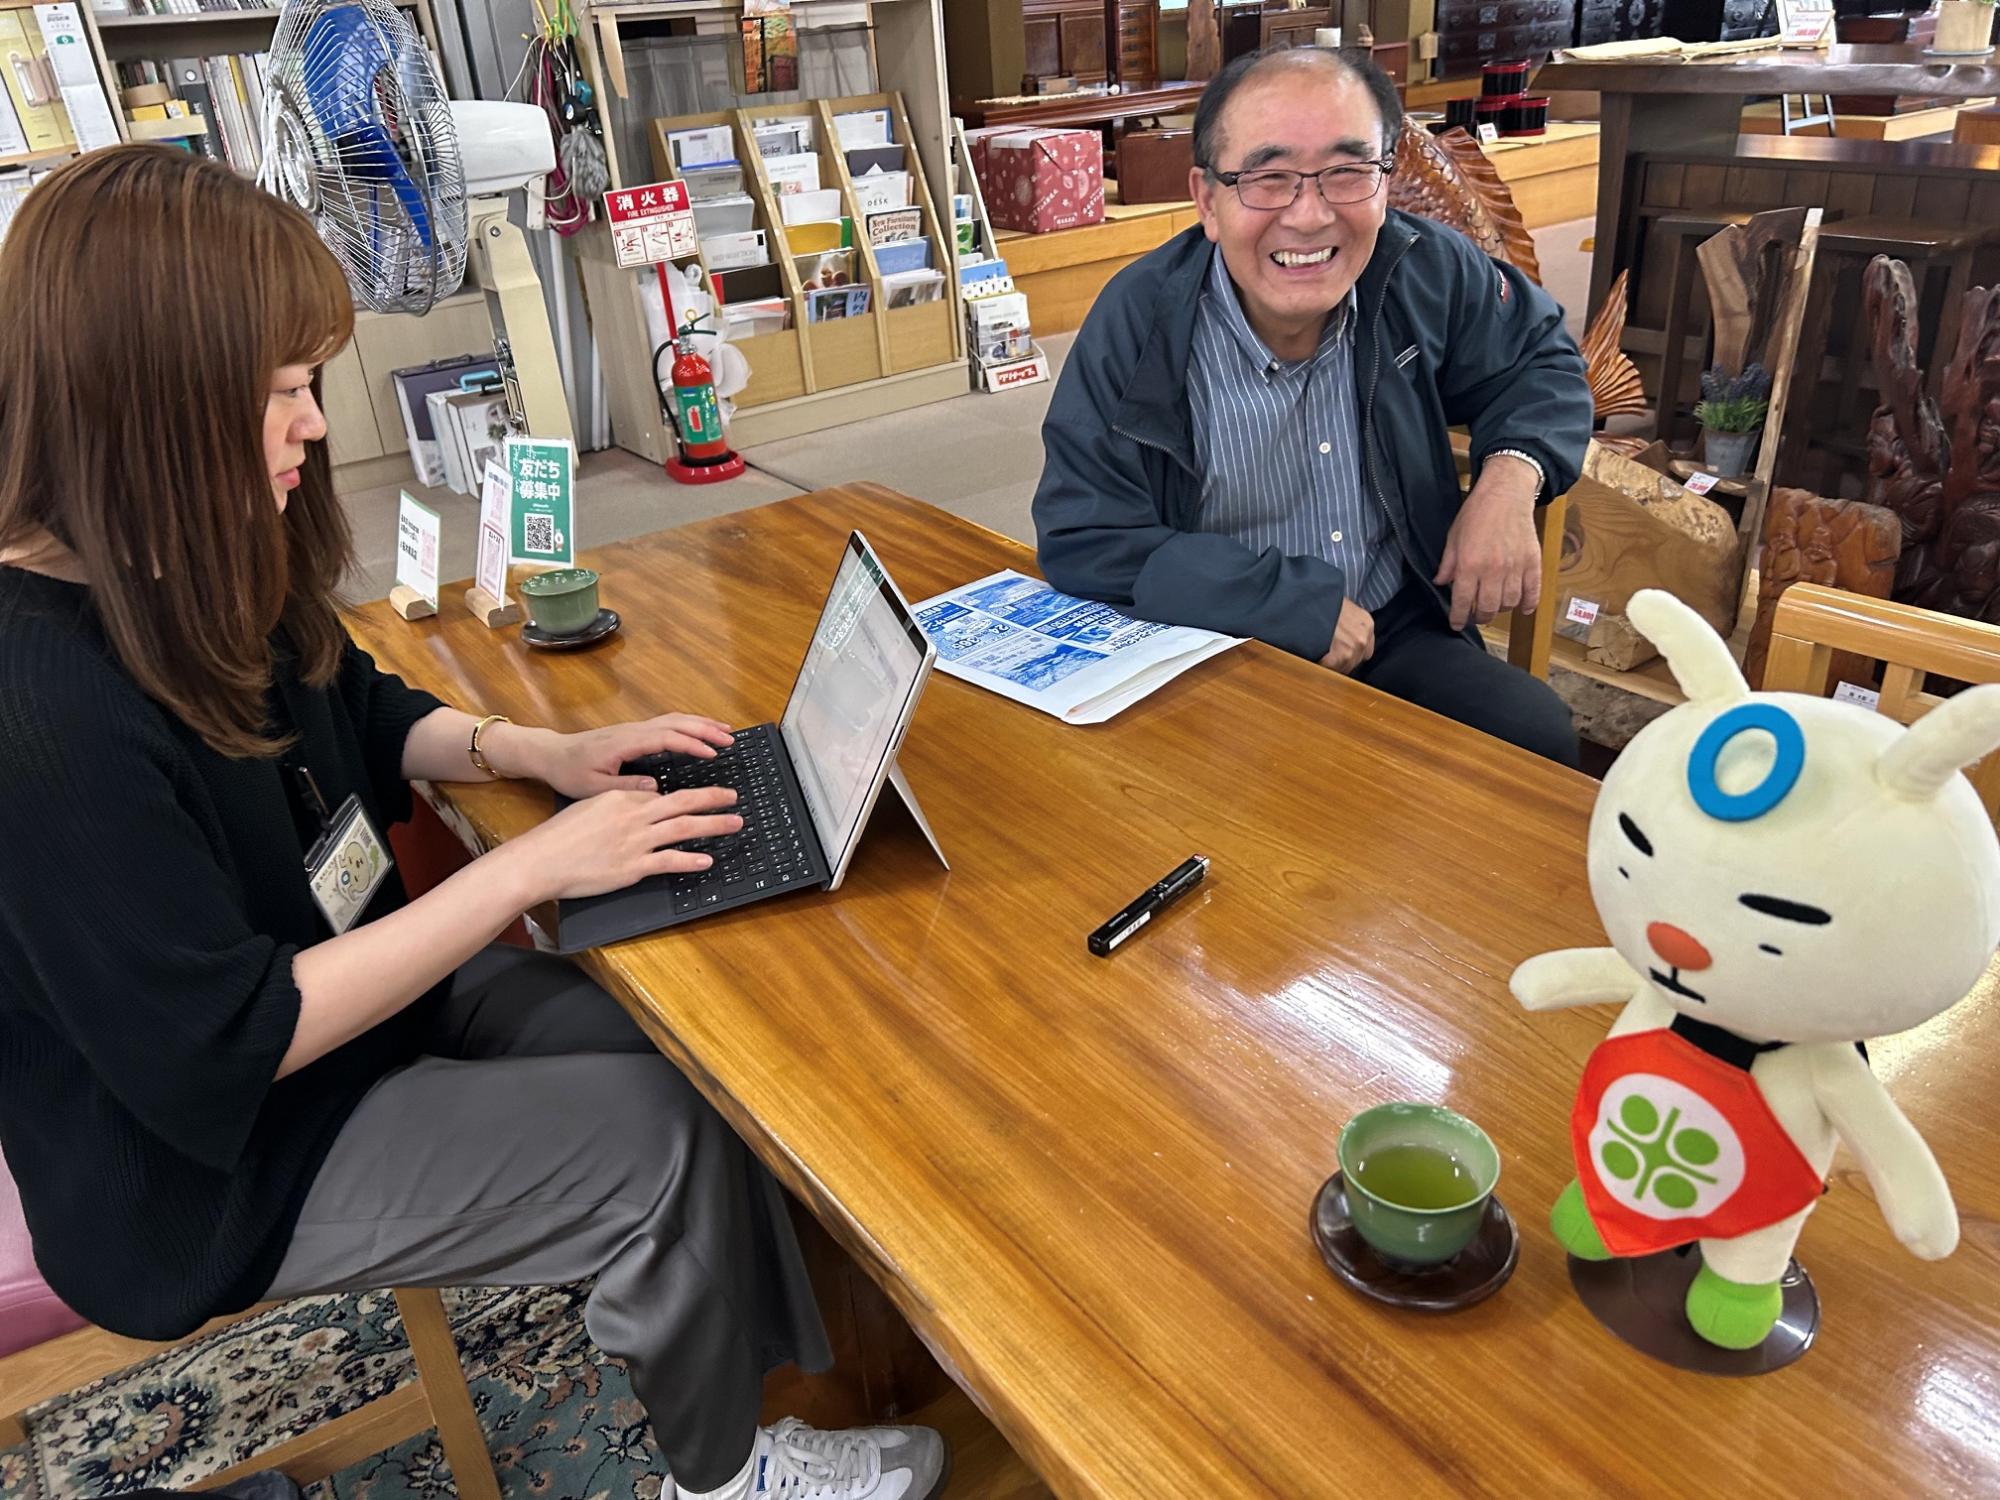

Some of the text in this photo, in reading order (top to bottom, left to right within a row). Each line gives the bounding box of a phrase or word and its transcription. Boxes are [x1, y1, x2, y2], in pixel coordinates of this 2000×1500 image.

[616, 186, 679, 211] 消火器
[867, 198, 888, 206] DESK
[627, 204, 674, 218] FIRE EXTINGUISHER
[872, 219, 886, 228] New
[872, 223, 916, 237] Collection
[519, 459, 561, 479] 友だち
[520, 480, 561, 501] 募集中
